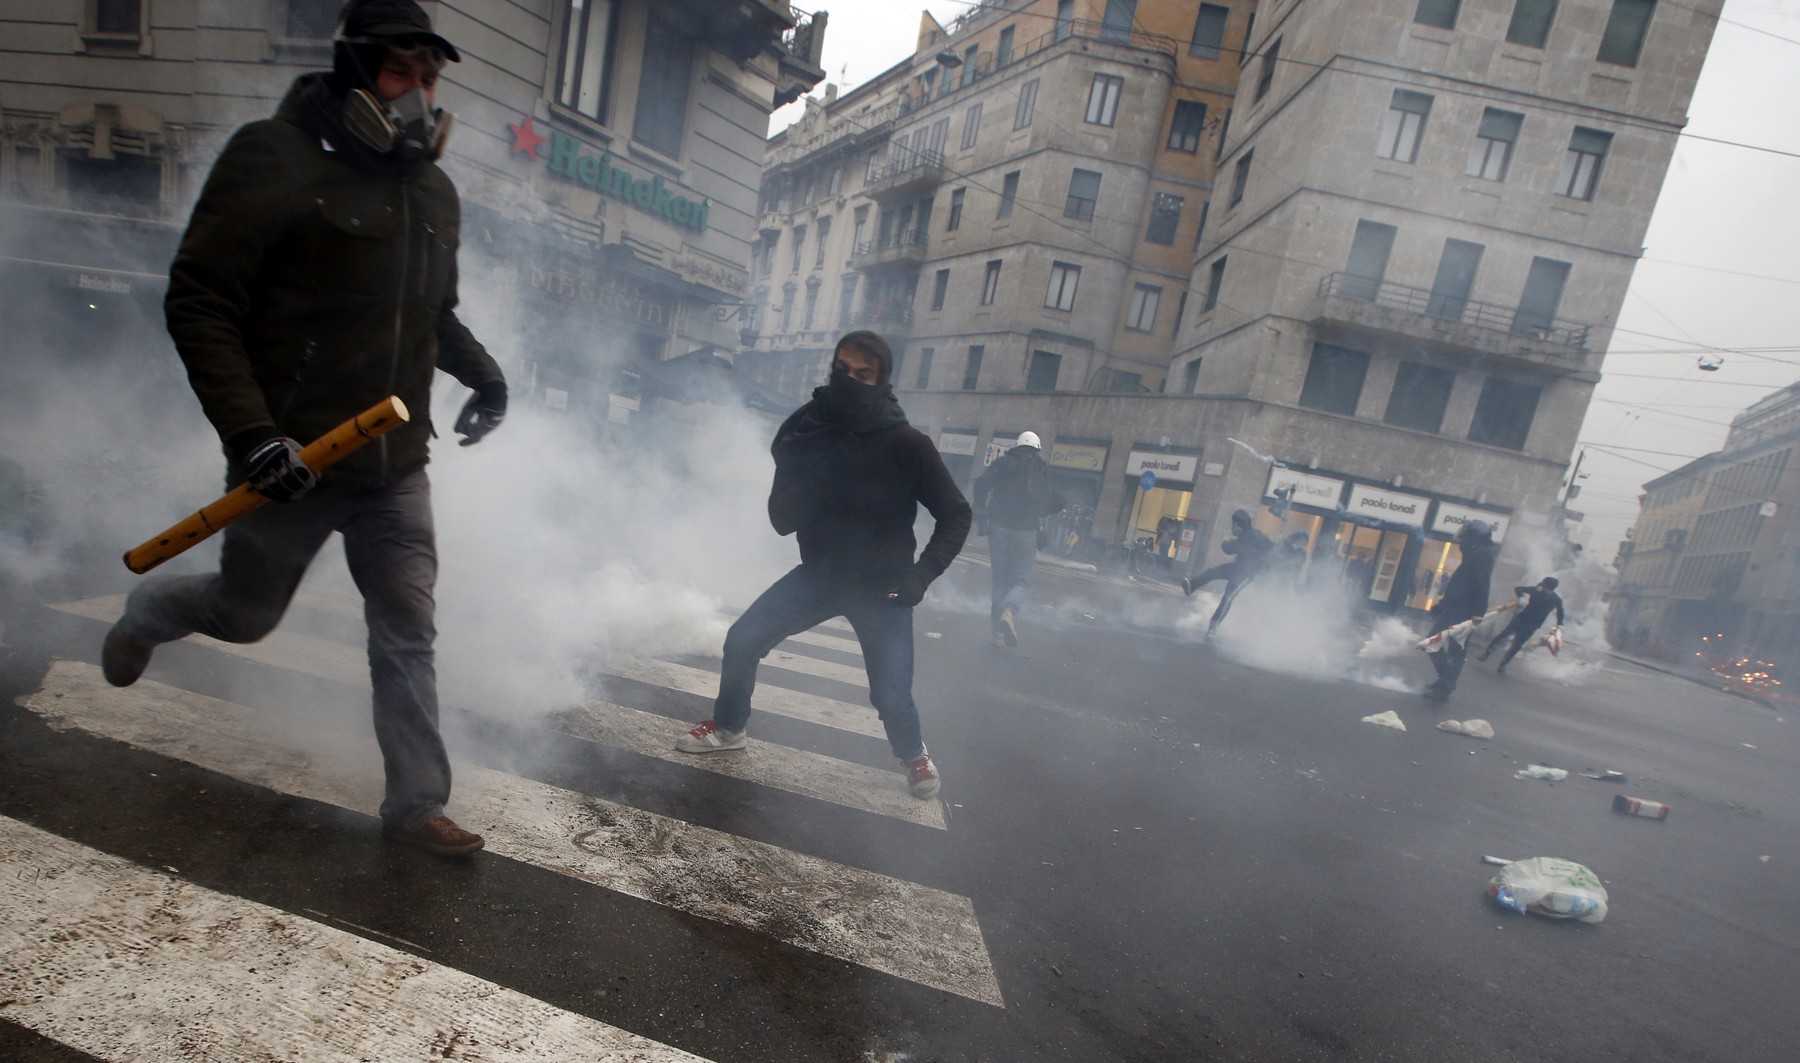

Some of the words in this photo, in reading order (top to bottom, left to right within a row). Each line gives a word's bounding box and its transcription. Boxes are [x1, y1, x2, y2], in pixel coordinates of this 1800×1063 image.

[547, 131, 709, 231] Heineken
[78, 274, 131, 294] Heineken
[530, 266, 663, 324] MAGENTA
[1360, 497, 1387, 510] paolo
[1389, 501, 1416, 515] tonali
[1443, 514, 1469, 524] paol
